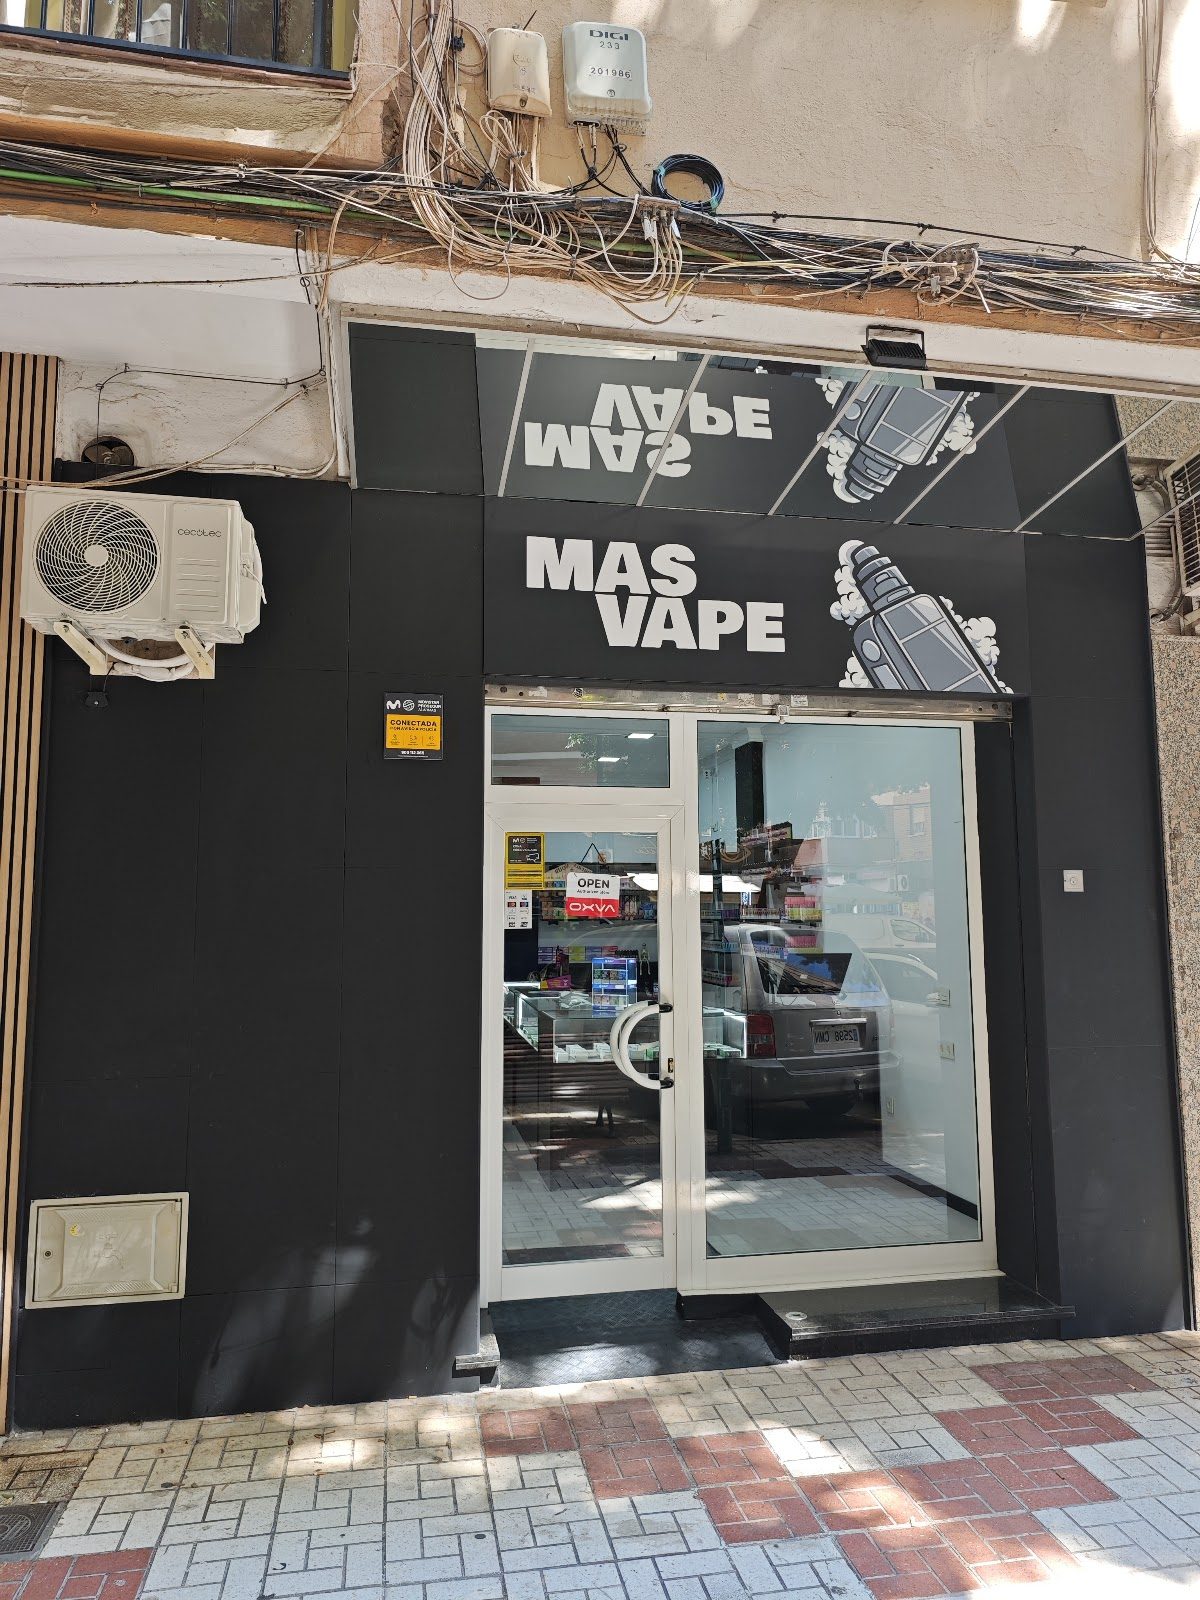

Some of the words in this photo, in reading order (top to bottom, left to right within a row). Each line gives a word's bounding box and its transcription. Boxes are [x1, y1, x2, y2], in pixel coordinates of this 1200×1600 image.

[589, 29, 629, 41] DIGI
[599, 40, 620, 50] 233
[590, 67, 631, 79] 201986
[526, 535, 697, 598] MAS
[594, 593, 786, 652] VAPE
[390, 719, 437, 727] CONECTADA
[577, 878, 610, 889] OPEN
[569, 902, 616, 913] OXVA
